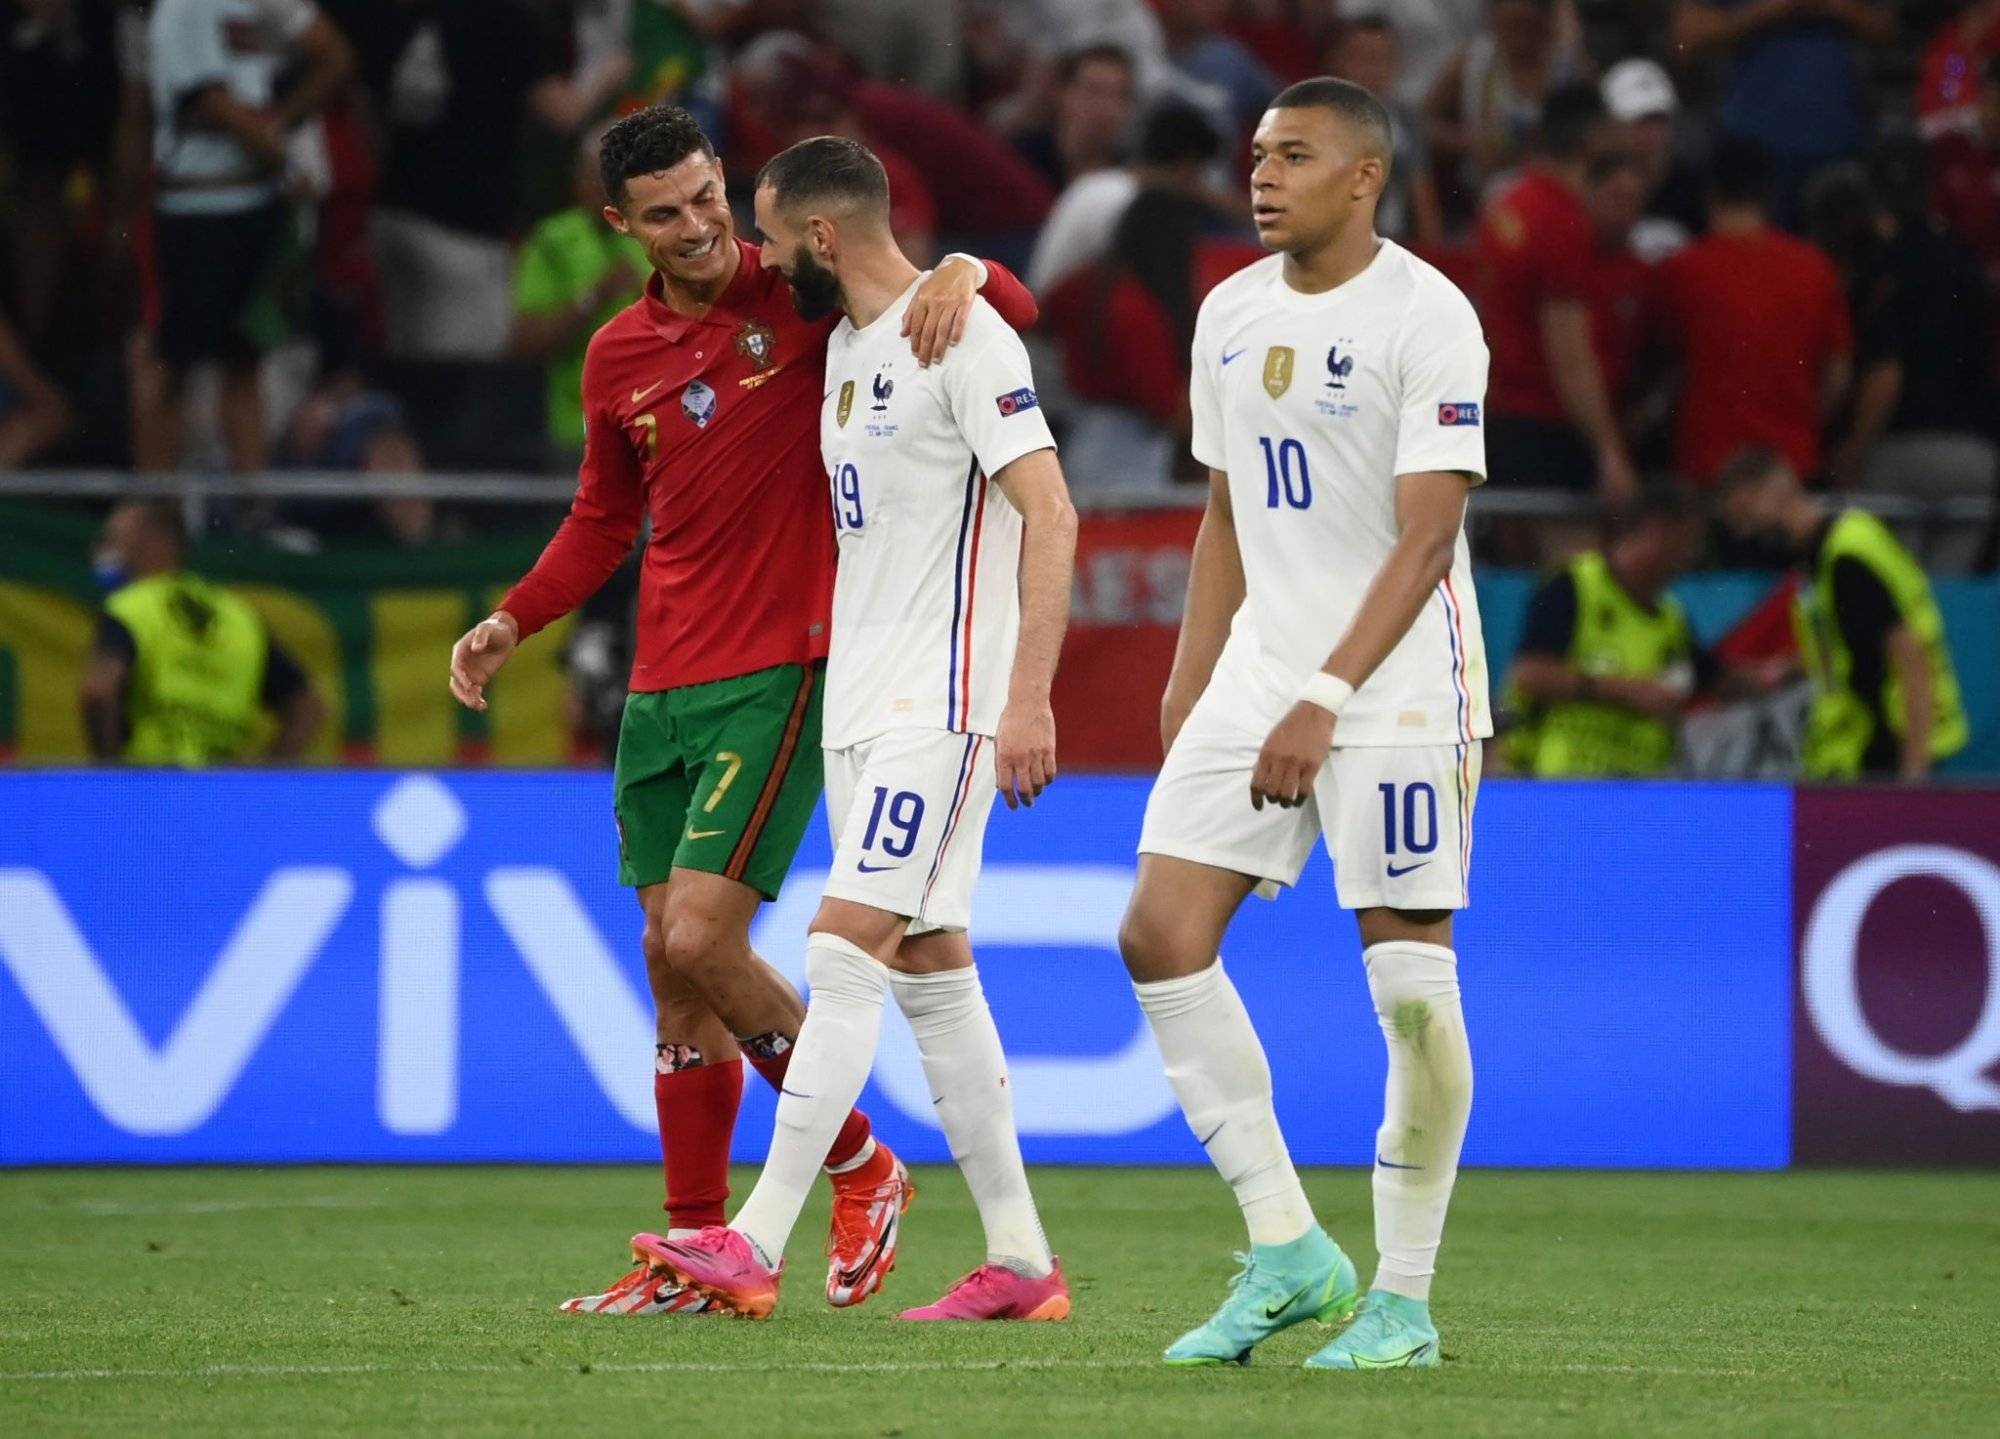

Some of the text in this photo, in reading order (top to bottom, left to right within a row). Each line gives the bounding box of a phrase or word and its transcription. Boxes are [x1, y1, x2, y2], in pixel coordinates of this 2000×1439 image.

[634, 413, 657, 464] 7
[1259, 437, 1312, 510] 10
[705, 752, 742, 813] 7
[1378, 782, 1439, 855] 10
[861, 786, 926, 858] 19
[1802, 843, 2000, 1112] Q
